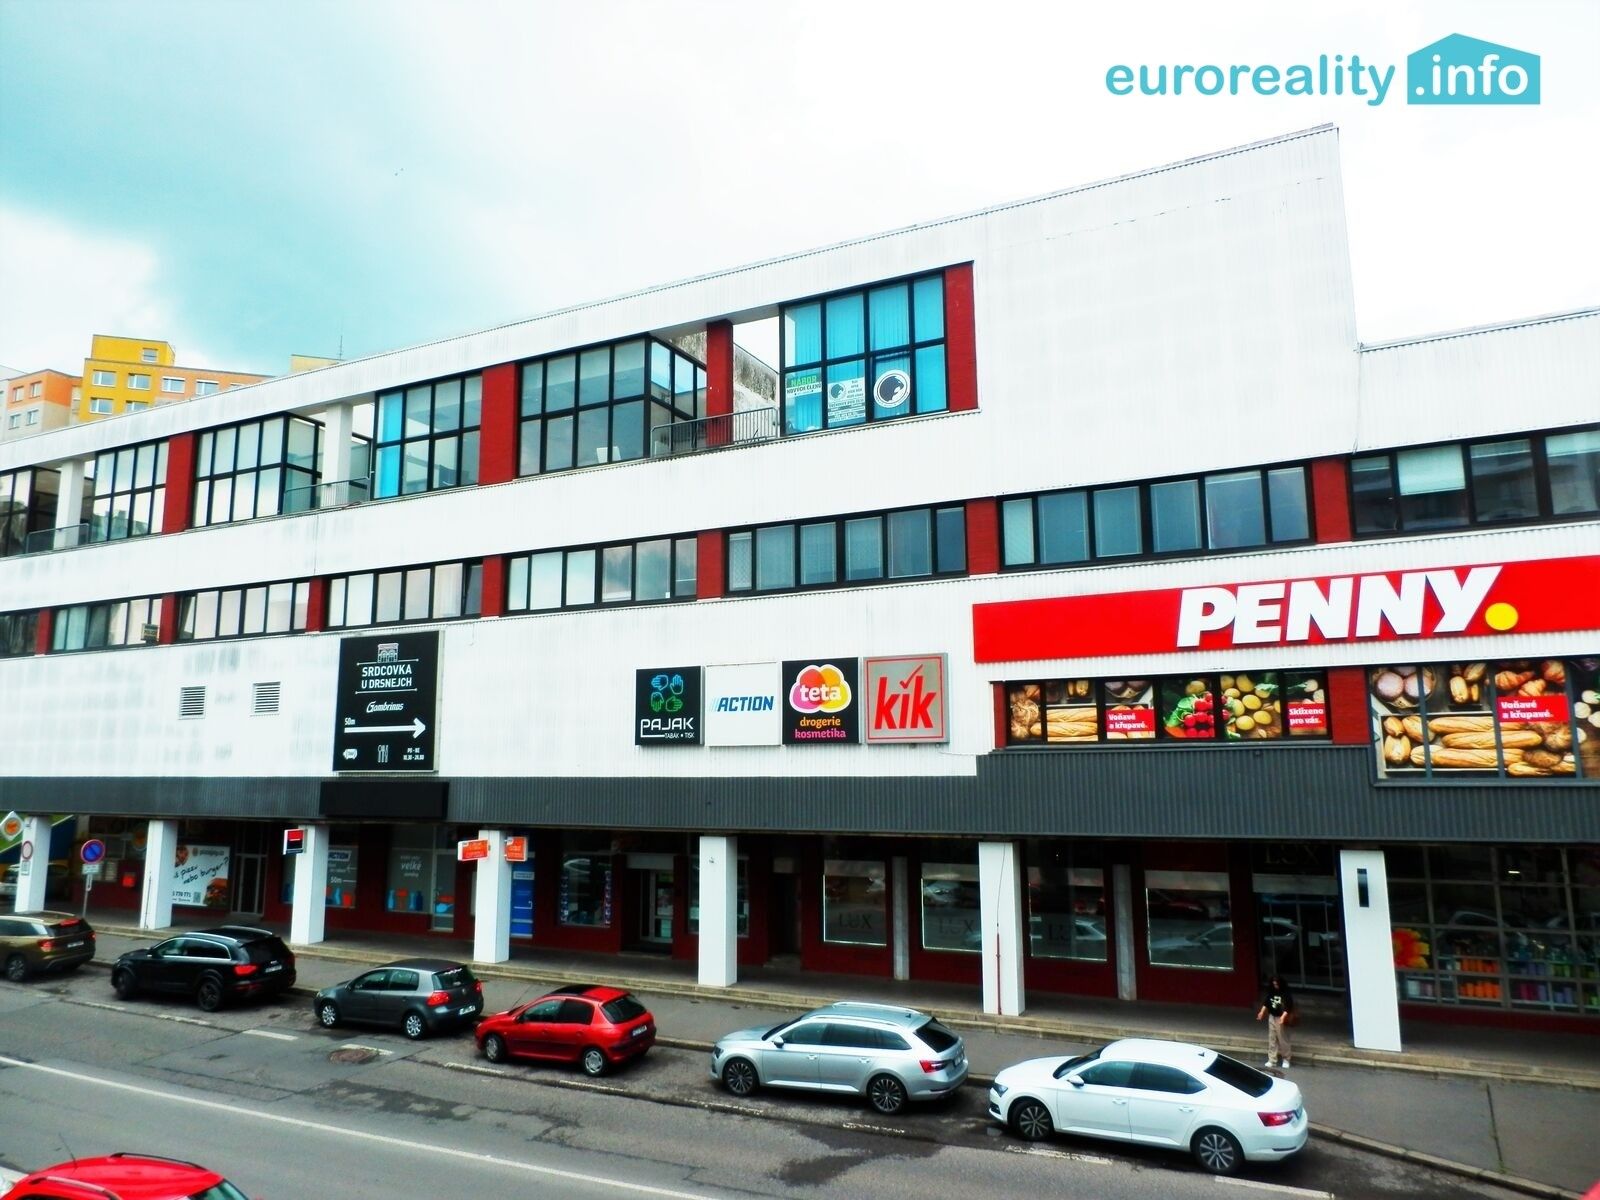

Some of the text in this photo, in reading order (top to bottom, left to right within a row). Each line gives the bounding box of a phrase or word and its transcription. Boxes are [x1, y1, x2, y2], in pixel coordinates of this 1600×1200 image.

[1177, 565, 1504, 648] PENNY
[362, 664, 412, 677] SRDCOVKA
[361, 677, 412, 689] U DRSNEJCH
[800, 684, 842, 702] teta
[366, 701, 404, 713] Gambrinus
[716, 696, 774, 712] ACTION
[1501, 700, 1537, 709] Voňavé
[1108, 712, 1136, 721] Voňavé
[1289, 707, 1324, 716] Sklizeno
[344, 717, 356, 726] 50m
[640, 717, 694, 733] PAJAK
[799, 716, 841, 729] drogerie
[1290, 717, 1303, 726] pro
[795, 728, 847, 739] kosmetika
